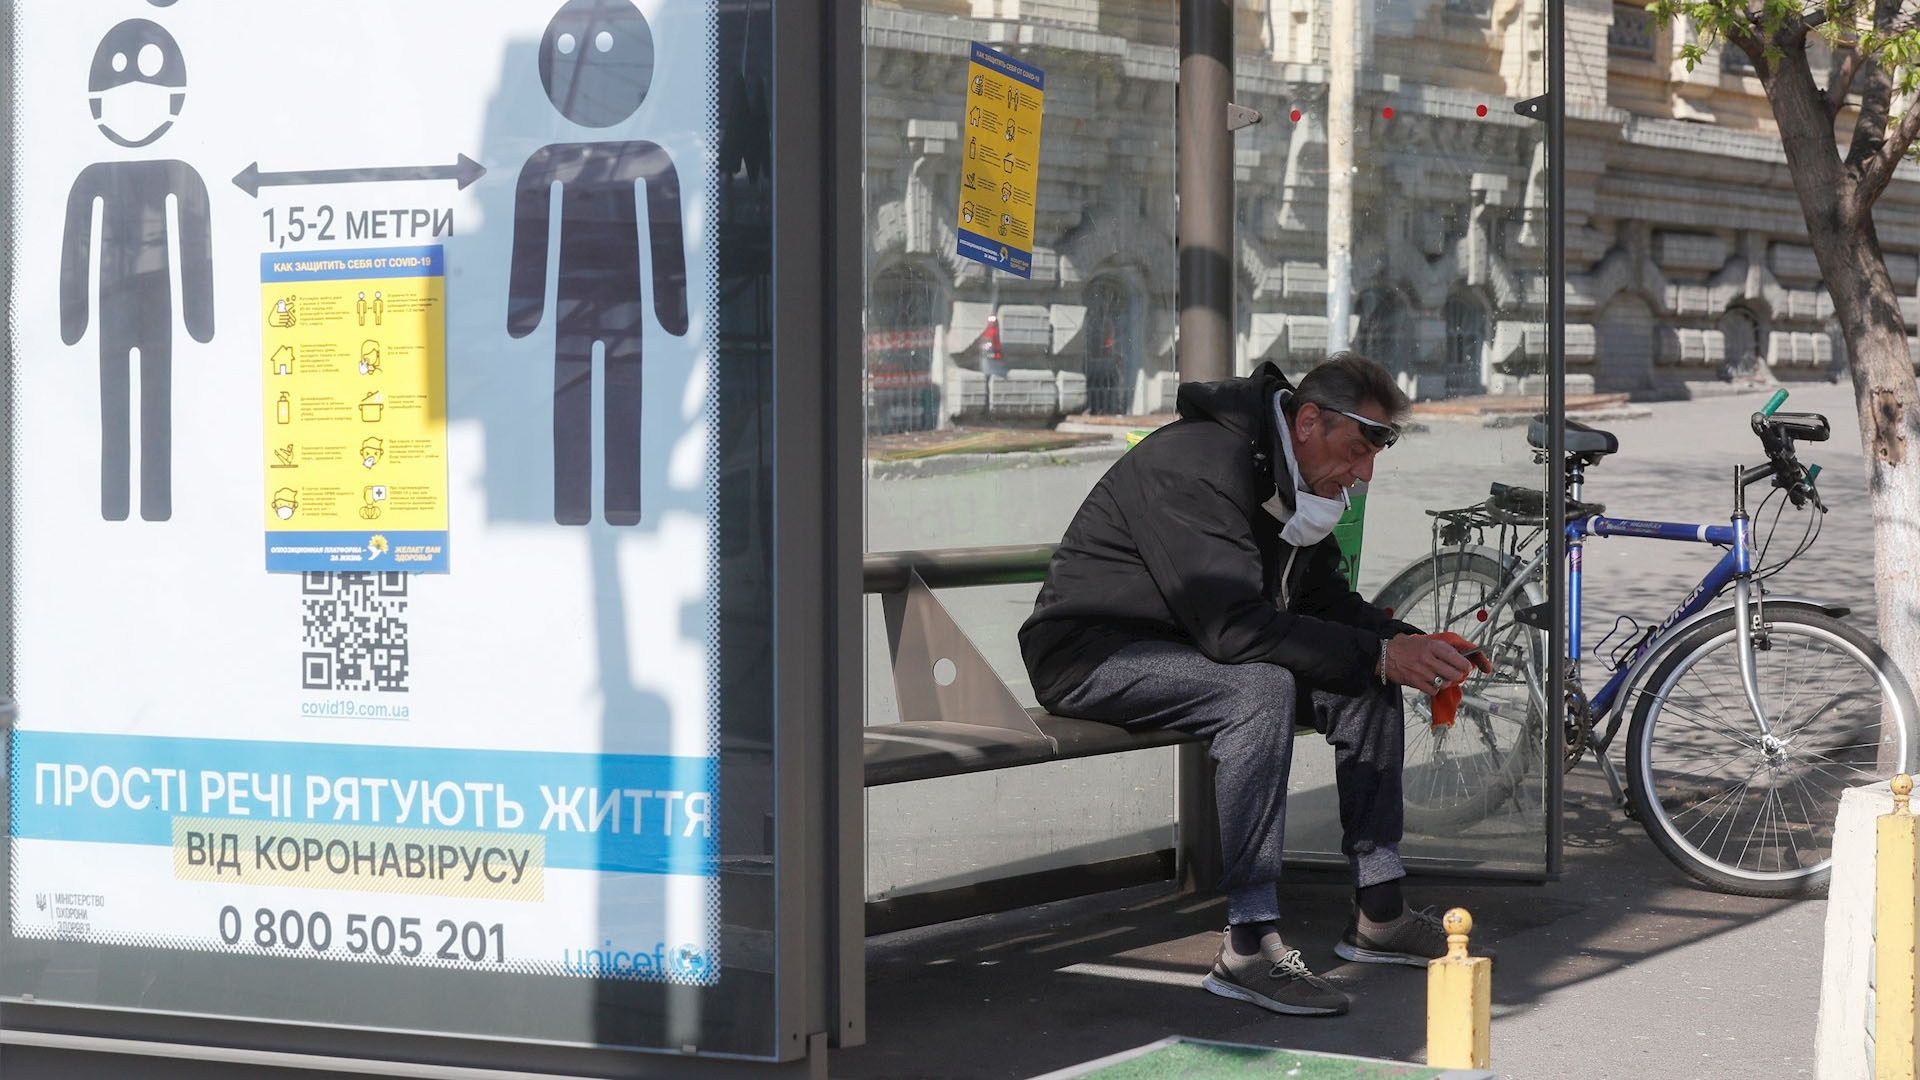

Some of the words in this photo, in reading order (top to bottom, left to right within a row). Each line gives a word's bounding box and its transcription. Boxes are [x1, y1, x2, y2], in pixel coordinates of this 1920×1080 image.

[263, 204, 336, 249] 1,5-2
[346, 208, 454, 240] МЕТРИ
[273, 262, 294, 272] КАК
[295, 260, 345, 273] ЗАЩИТИТЬ
[347, 259, 374, 269] СЕБЯ
[374, 258, 387, 268] ОТ
[389, 256, 432, 268] COVID-19
[301, 699, 409, 718] covid19.com.ua
[35, 762, 188, 812] ПРОСТІ
[200, 770, 292, 819] РЕЧІ
[306, 775, 526, 830] РЯТУЮТЬ
[538, 785, 711, 838] ЖИТТЯ
[186, 831, 242, 877] ВІД
[255, 835, 531, 885] КОРОНАВІРУСУ
[55, 893, 105, 907] МІНІСТЕРСТВО
[56, 907, 89, 920] ОХОРОНИ
[219, 905, 241, 945] 0
[254, 908, 332, 952] 800
[346, 913, 423, 958] 505
[435, 919, 504, 964] 201
[564, 940, 665, 979] unicef
